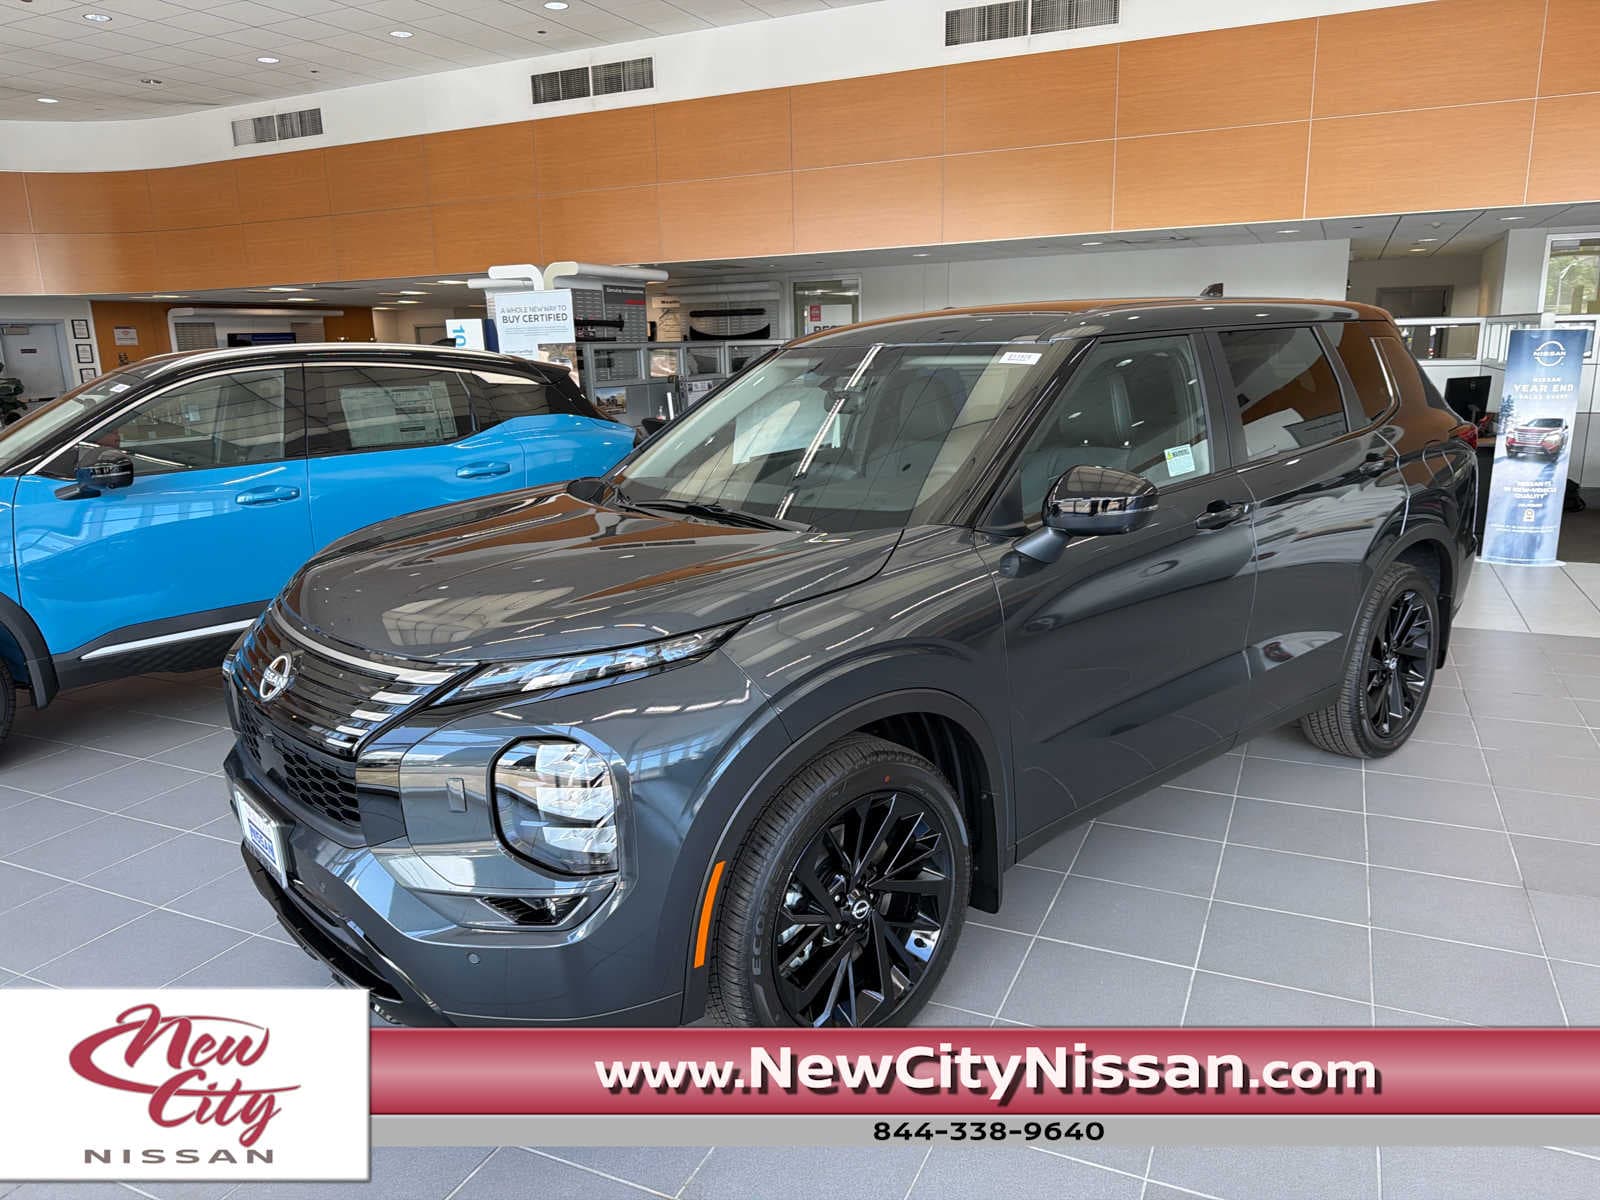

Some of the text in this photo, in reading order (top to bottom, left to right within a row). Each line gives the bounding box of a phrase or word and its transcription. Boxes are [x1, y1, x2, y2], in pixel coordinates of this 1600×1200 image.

[557, 304, 567, 312] TO
[502, 312, 568, 324] BUY CERTIFIED
[1513, 383, 1574, 393] YEAR END
